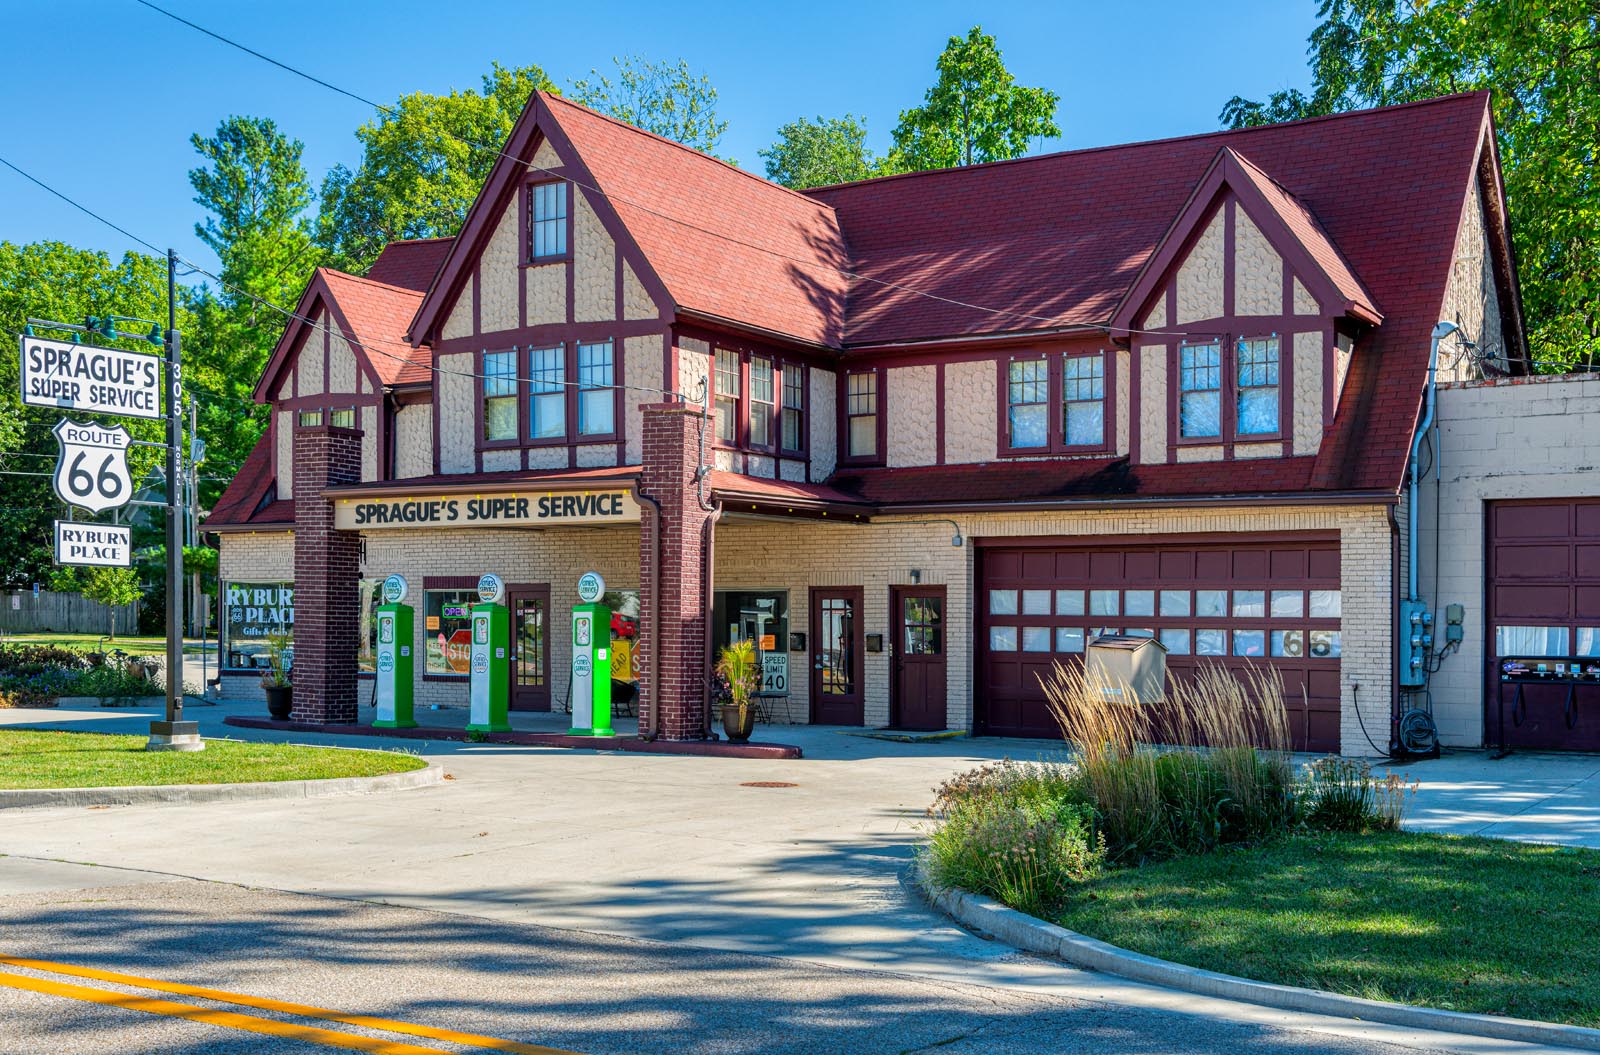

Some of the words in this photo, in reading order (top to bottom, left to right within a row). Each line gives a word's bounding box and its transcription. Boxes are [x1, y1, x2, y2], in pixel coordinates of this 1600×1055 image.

[29, 345, 155, 388] SPRAGUE'S
[31, 377, 80, 402] SUPER
[89, 384, 153, 411] SERVICE
[173, 363, 182, 416] 305
[67, 428, 122, 445] ROUTE
[68, 451, 122, 498] 66
[355, 500, 459, 524] SPRAGUE'S
[466, 495, 529, 521] SUPER
[537, 493, 623, 518] SERVICE
[62, 529, 128, 545] RYBURN
[70, 545, 121, 560] PLACE
[226, 589, 293, 606] RYBUR
[444, 607, 467, 616] OPEN
[450, 643, 471, 660] STO
[765, 656, 786, 665] SPEED
[766, 666, 784, 674] LIMIT
[765, 675, 785, 690] 40
